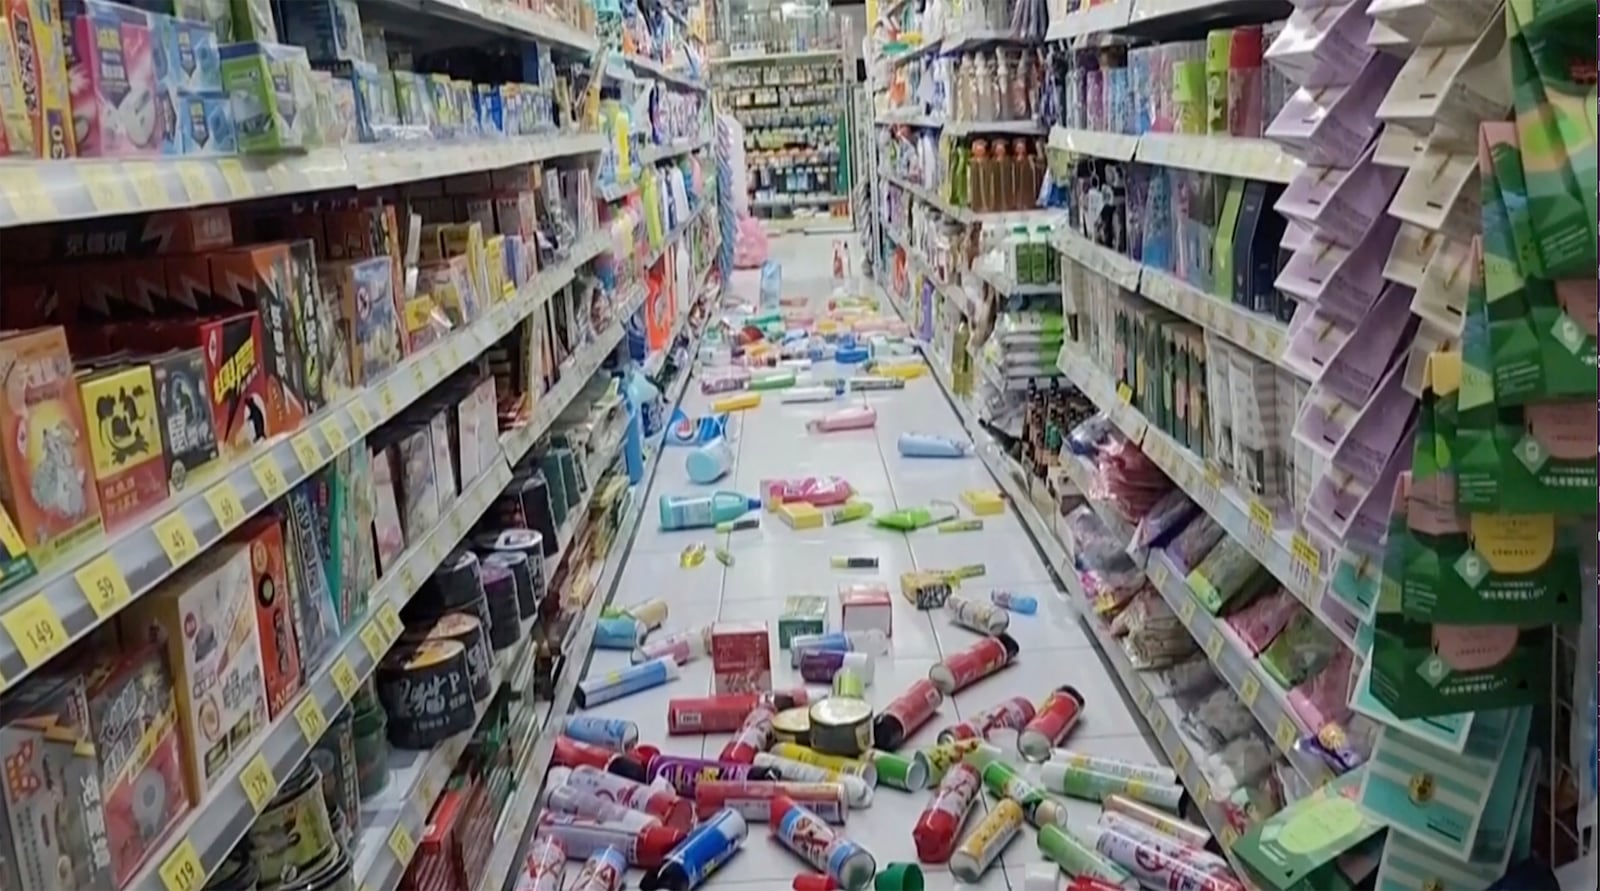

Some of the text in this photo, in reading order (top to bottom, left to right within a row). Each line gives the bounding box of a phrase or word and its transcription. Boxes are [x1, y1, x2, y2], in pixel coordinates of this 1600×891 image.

[96, 575, 115, 598] 59
[26, 619, 55, 650] 149
[251, 771, 268, 793] 179
[175, 861, 195, 888] 119
